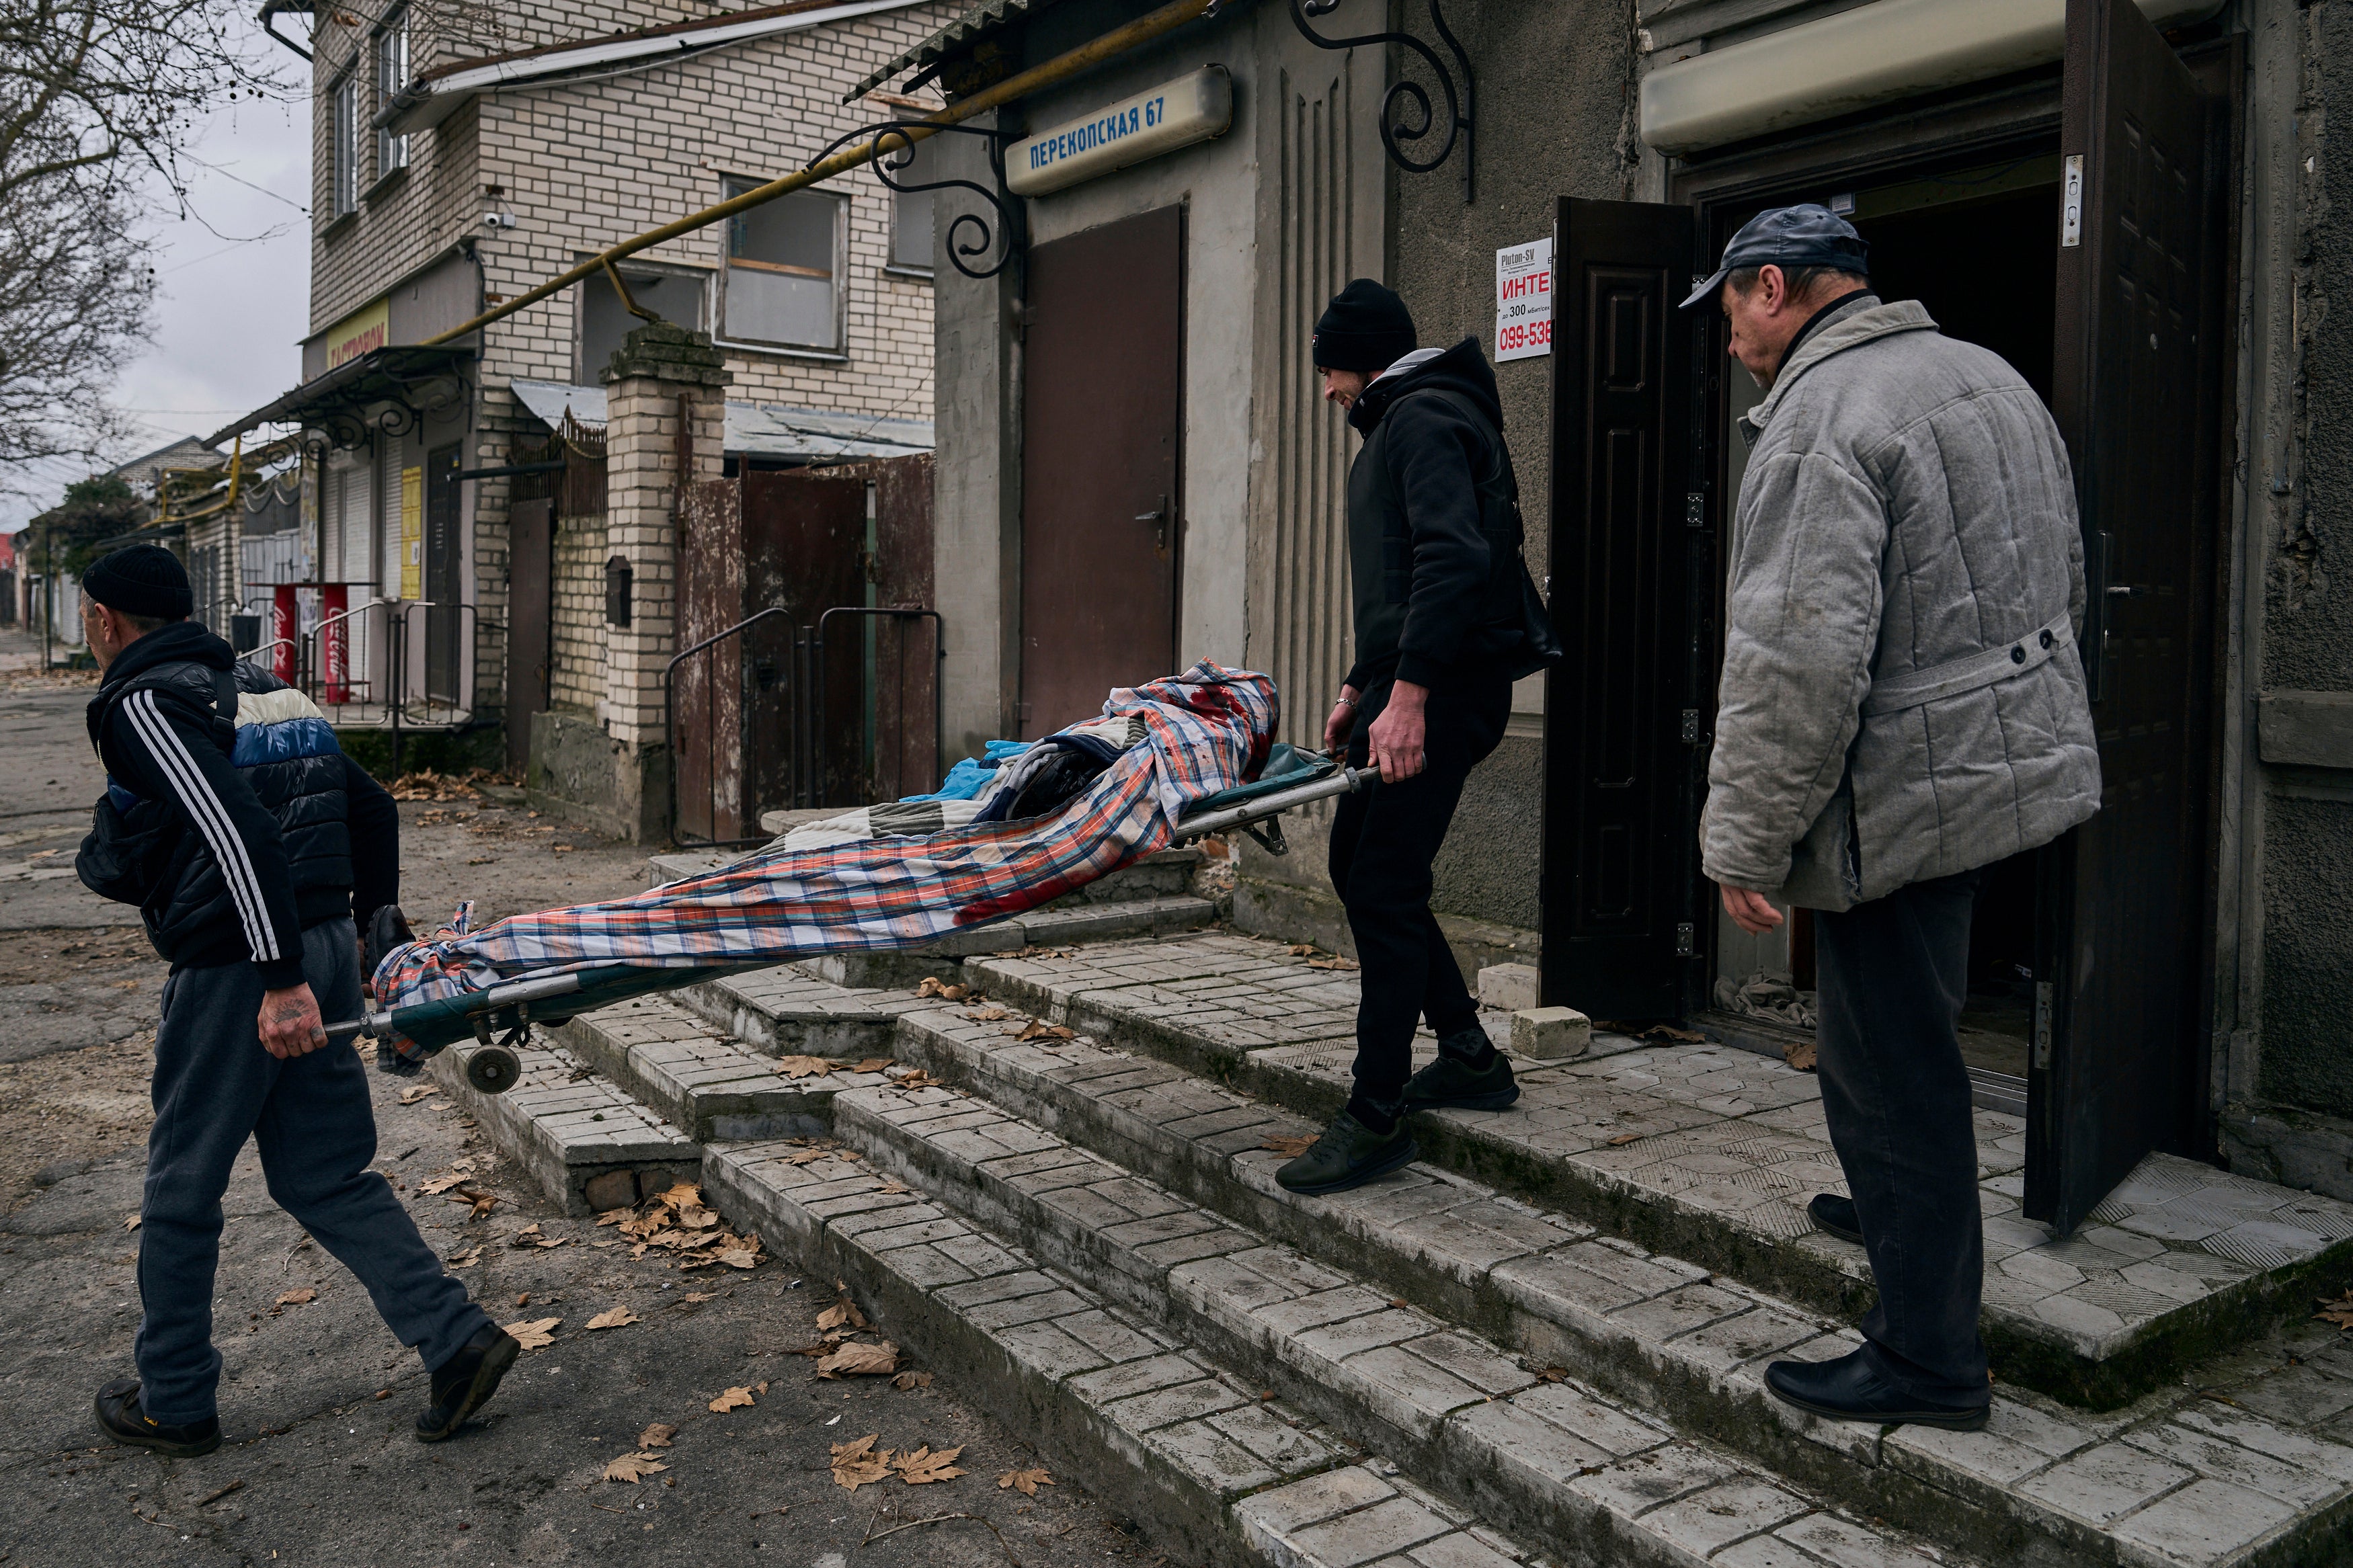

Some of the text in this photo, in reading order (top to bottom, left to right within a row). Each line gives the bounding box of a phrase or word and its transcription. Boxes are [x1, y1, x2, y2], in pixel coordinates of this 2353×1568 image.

[1030, 97, 1164, 169] ПЕРЕКОПСКАЯ 67
[1501, 248, 1535, 267] Pluton-SV
[1503, 271, 1550, 300] ИНТЕ
[1509, 304, 1526, 317] 300
